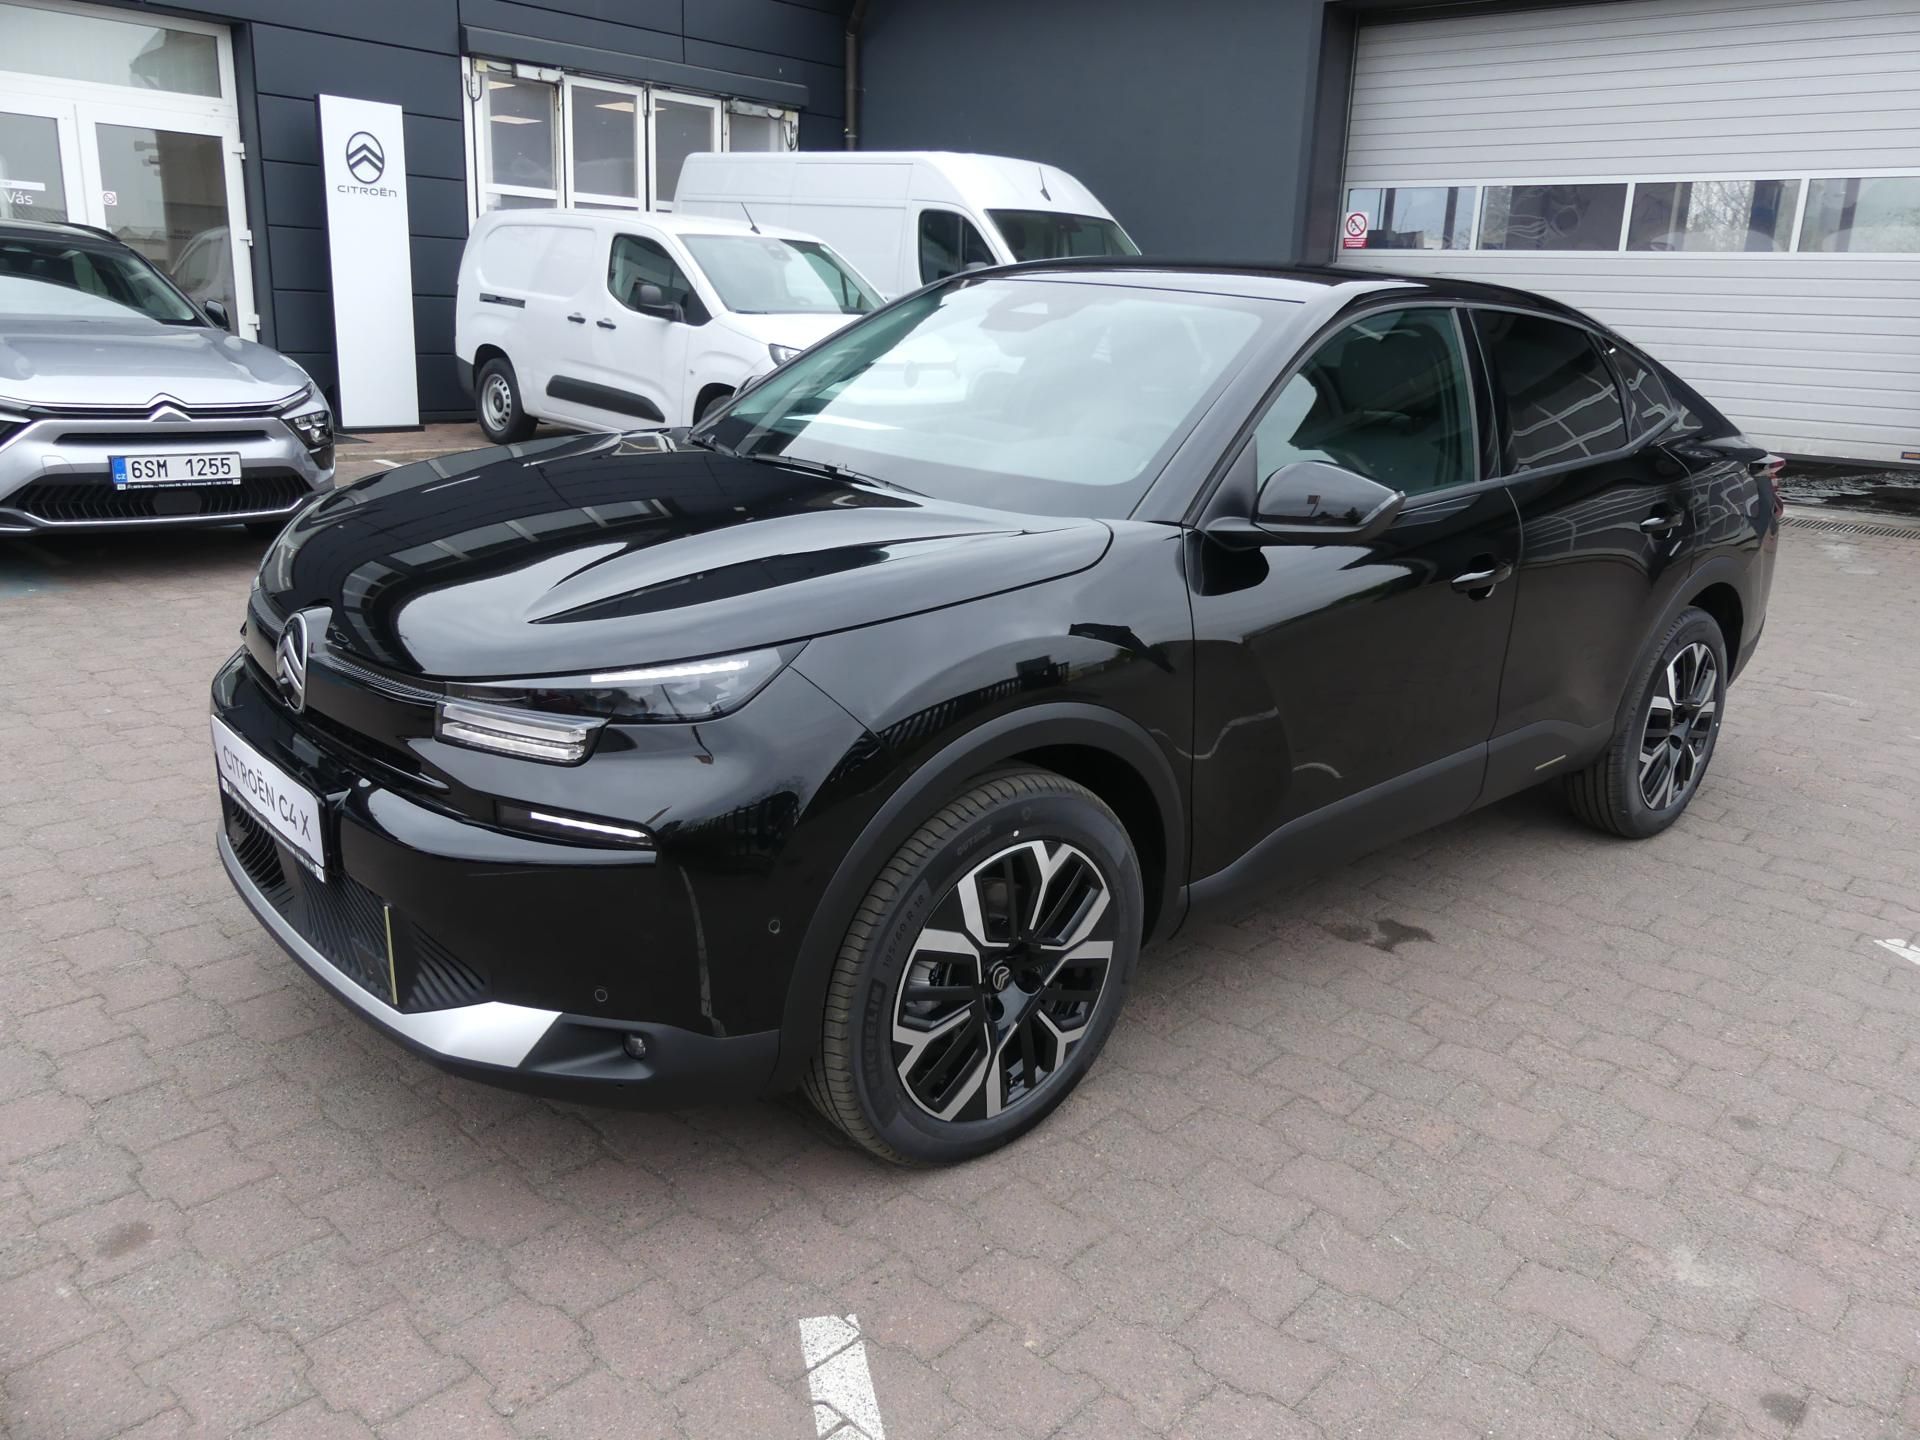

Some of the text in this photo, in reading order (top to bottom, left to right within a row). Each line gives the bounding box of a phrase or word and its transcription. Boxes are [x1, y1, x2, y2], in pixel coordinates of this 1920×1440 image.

[4, 191, 33, 205] Vás
[131, 457, 231, 479] 6SM 1255
[223, 745, 312, 842] CITROËN C4 X
